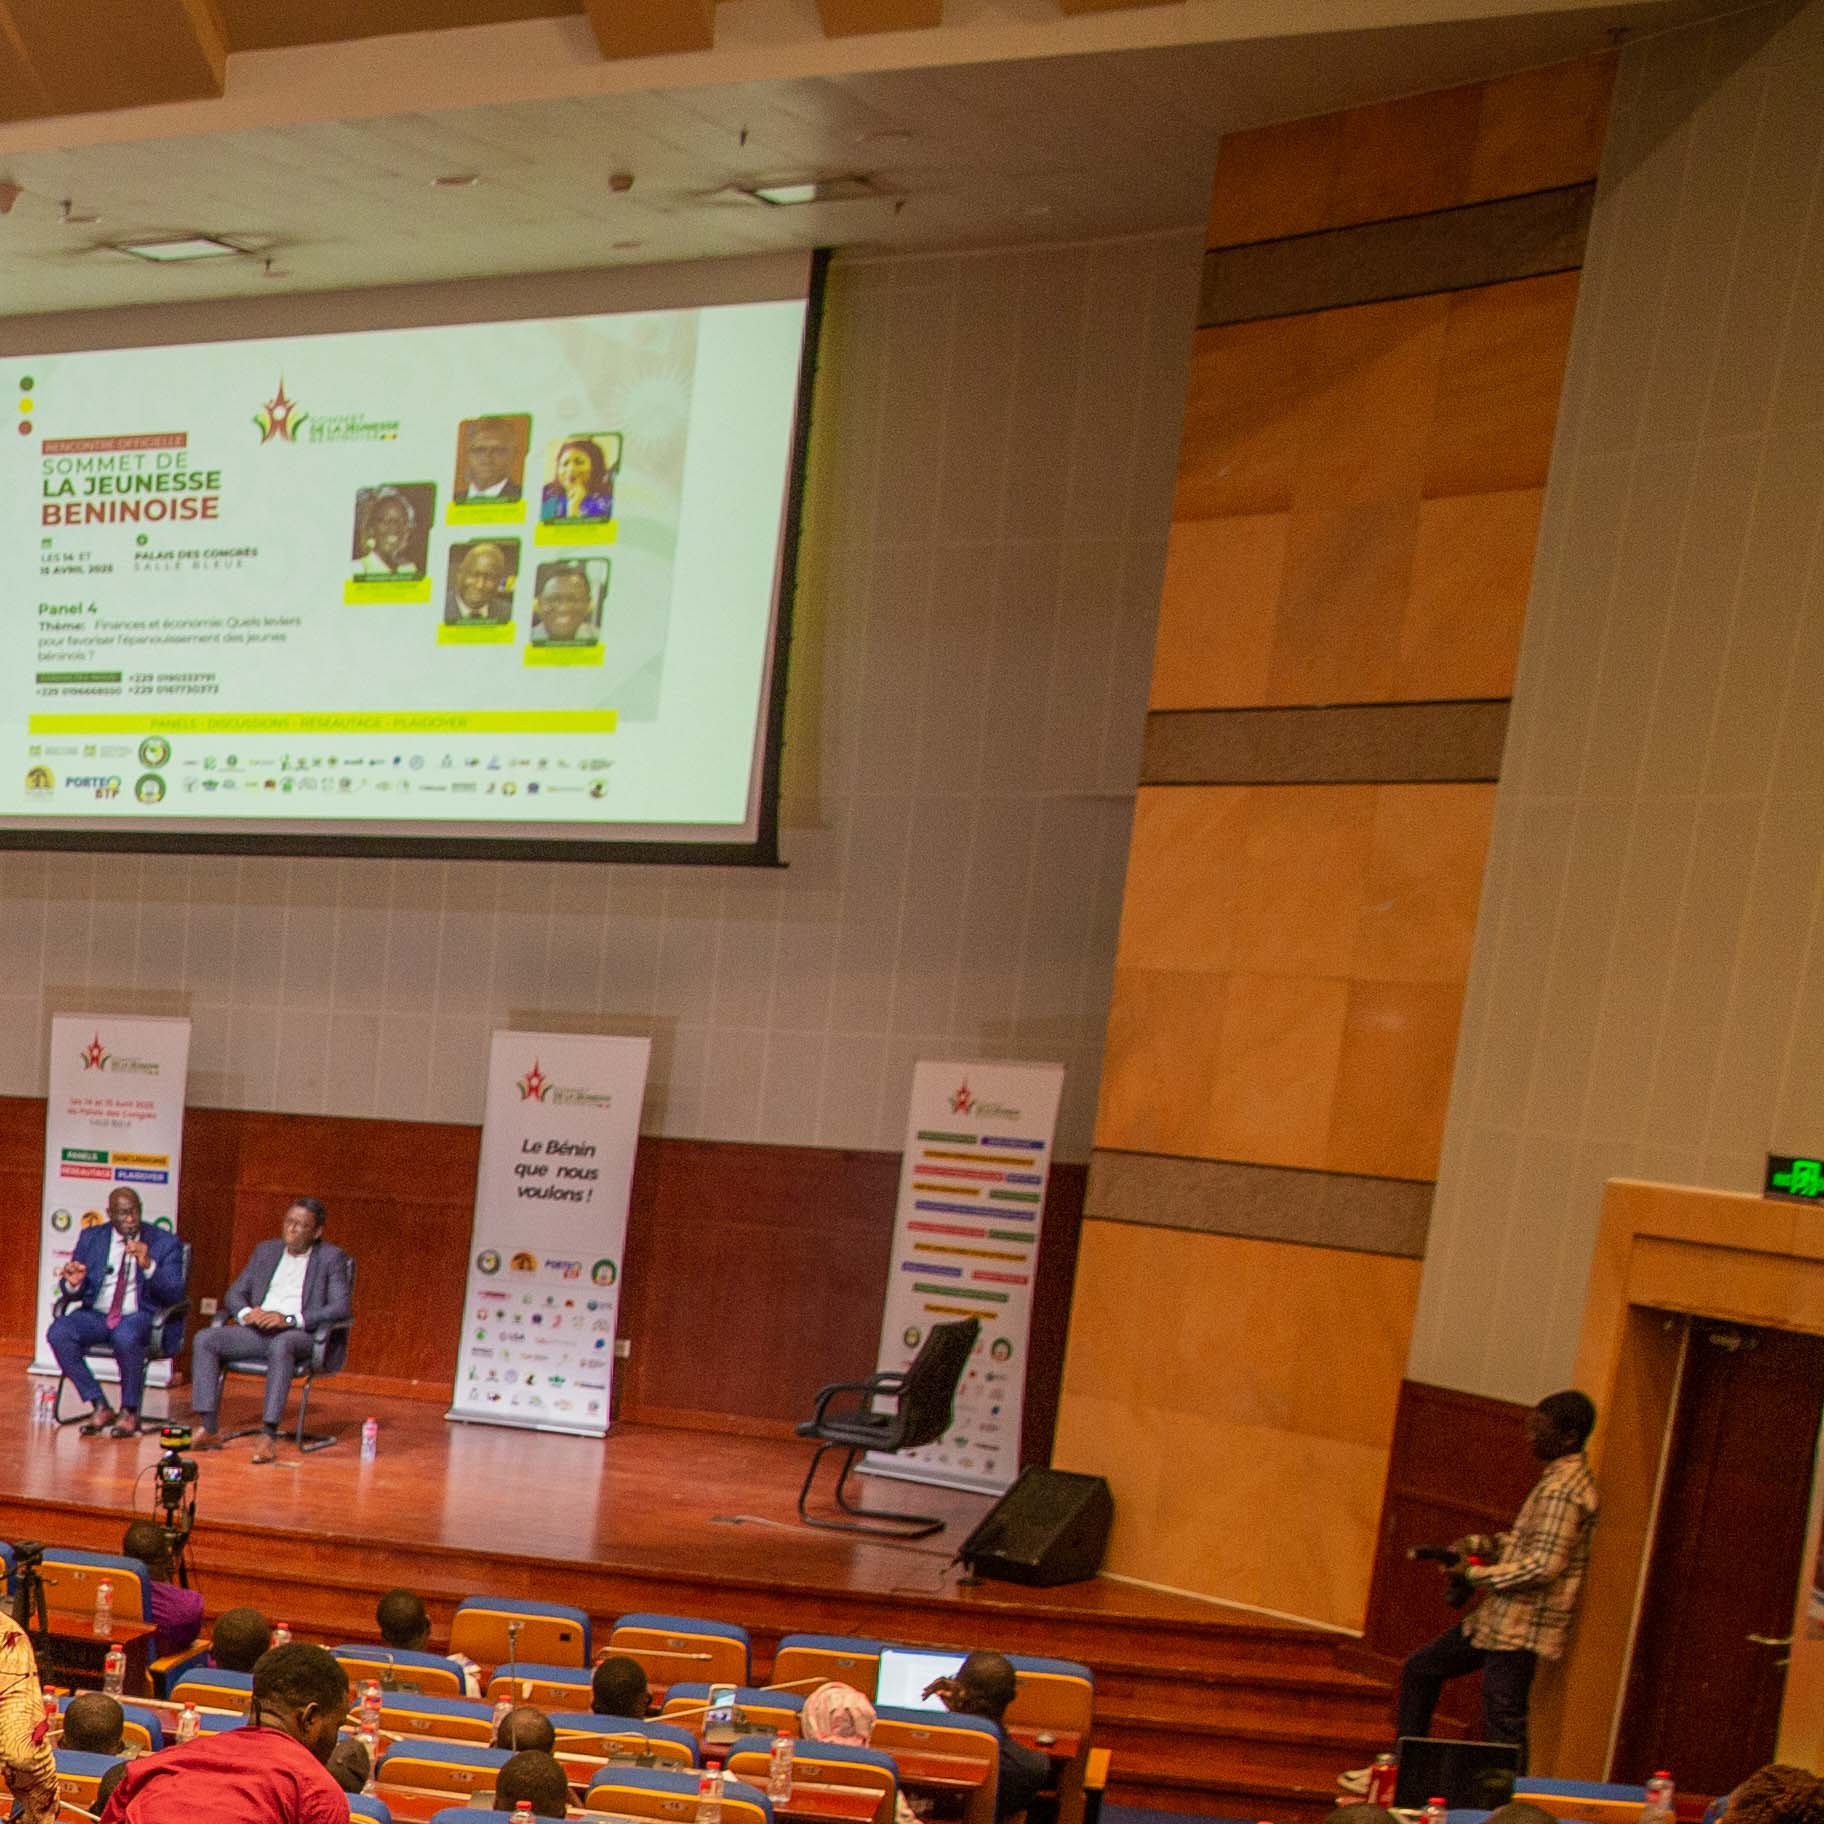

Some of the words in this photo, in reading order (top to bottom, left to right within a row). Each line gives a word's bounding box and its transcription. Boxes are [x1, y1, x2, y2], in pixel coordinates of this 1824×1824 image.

[42, 453, 146, 475] SOMMET
[157, 451, 188, 470] DE
[43, 477, 75, 497] LA
[84, 470, 221, 496] JEUNESSE
[42, 496, 220, 526] BENINOISE
[39, 601, 83, 615] Panel
[87, 601, 97, 614] 4
[522, 1139, 542, 1154] Le
[546, 1139, 596, 1157] Bénin
[514, 1163, 548, 1178] que
[557, 1165, 600, 1180] nous
[518, 1185, 583, 1202] voulons
